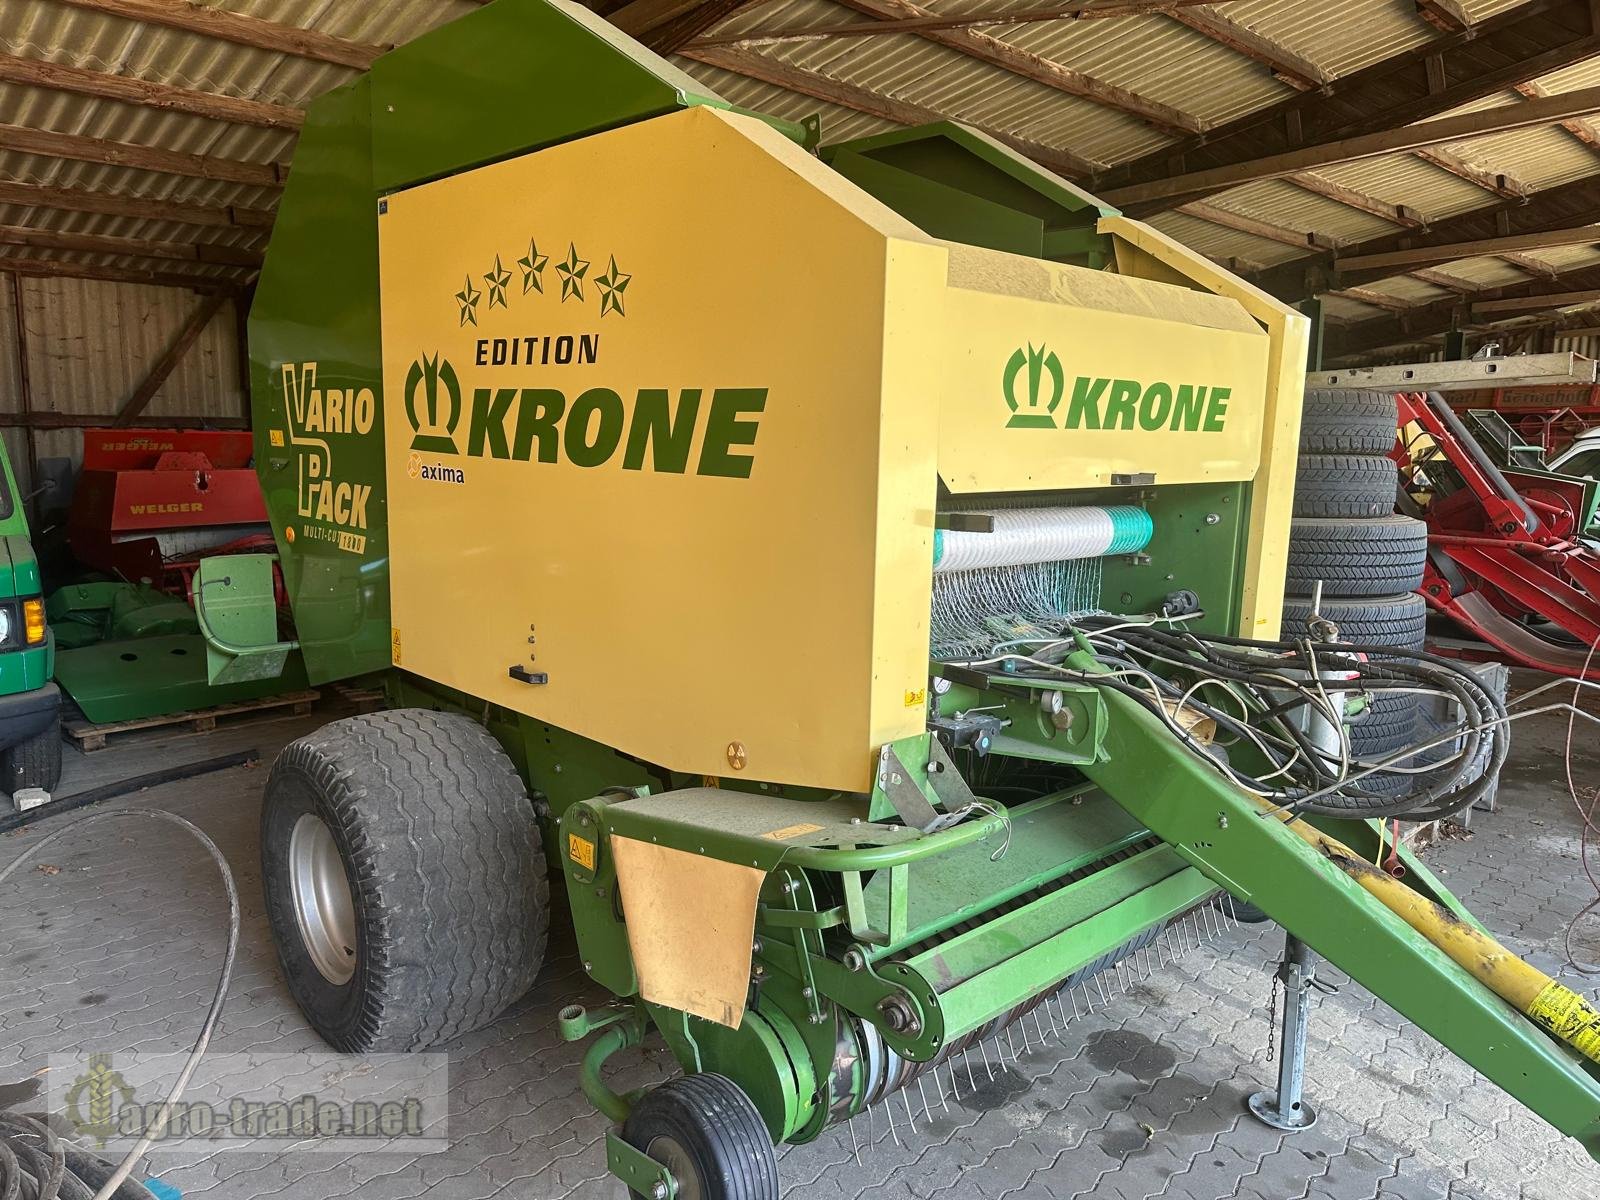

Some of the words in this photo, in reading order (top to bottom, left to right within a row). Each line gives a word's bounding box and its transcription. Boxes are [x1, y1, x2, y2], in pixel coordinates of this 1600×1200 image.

[475, 333, 599, 366] EDITION
[282, 362, 375, 435] VARIO
[1064, 376, 1232, 432] KRONE
[102, 442, 174, 451] WELGER
[467, 387, 769, 479] KRONE
[292, 437, 372, 530] PACK
[421, 462, 465, 484] axima
[130, 502, 204, 515] WELGER
[304, 525, 340, 543] MULTI-CUT
